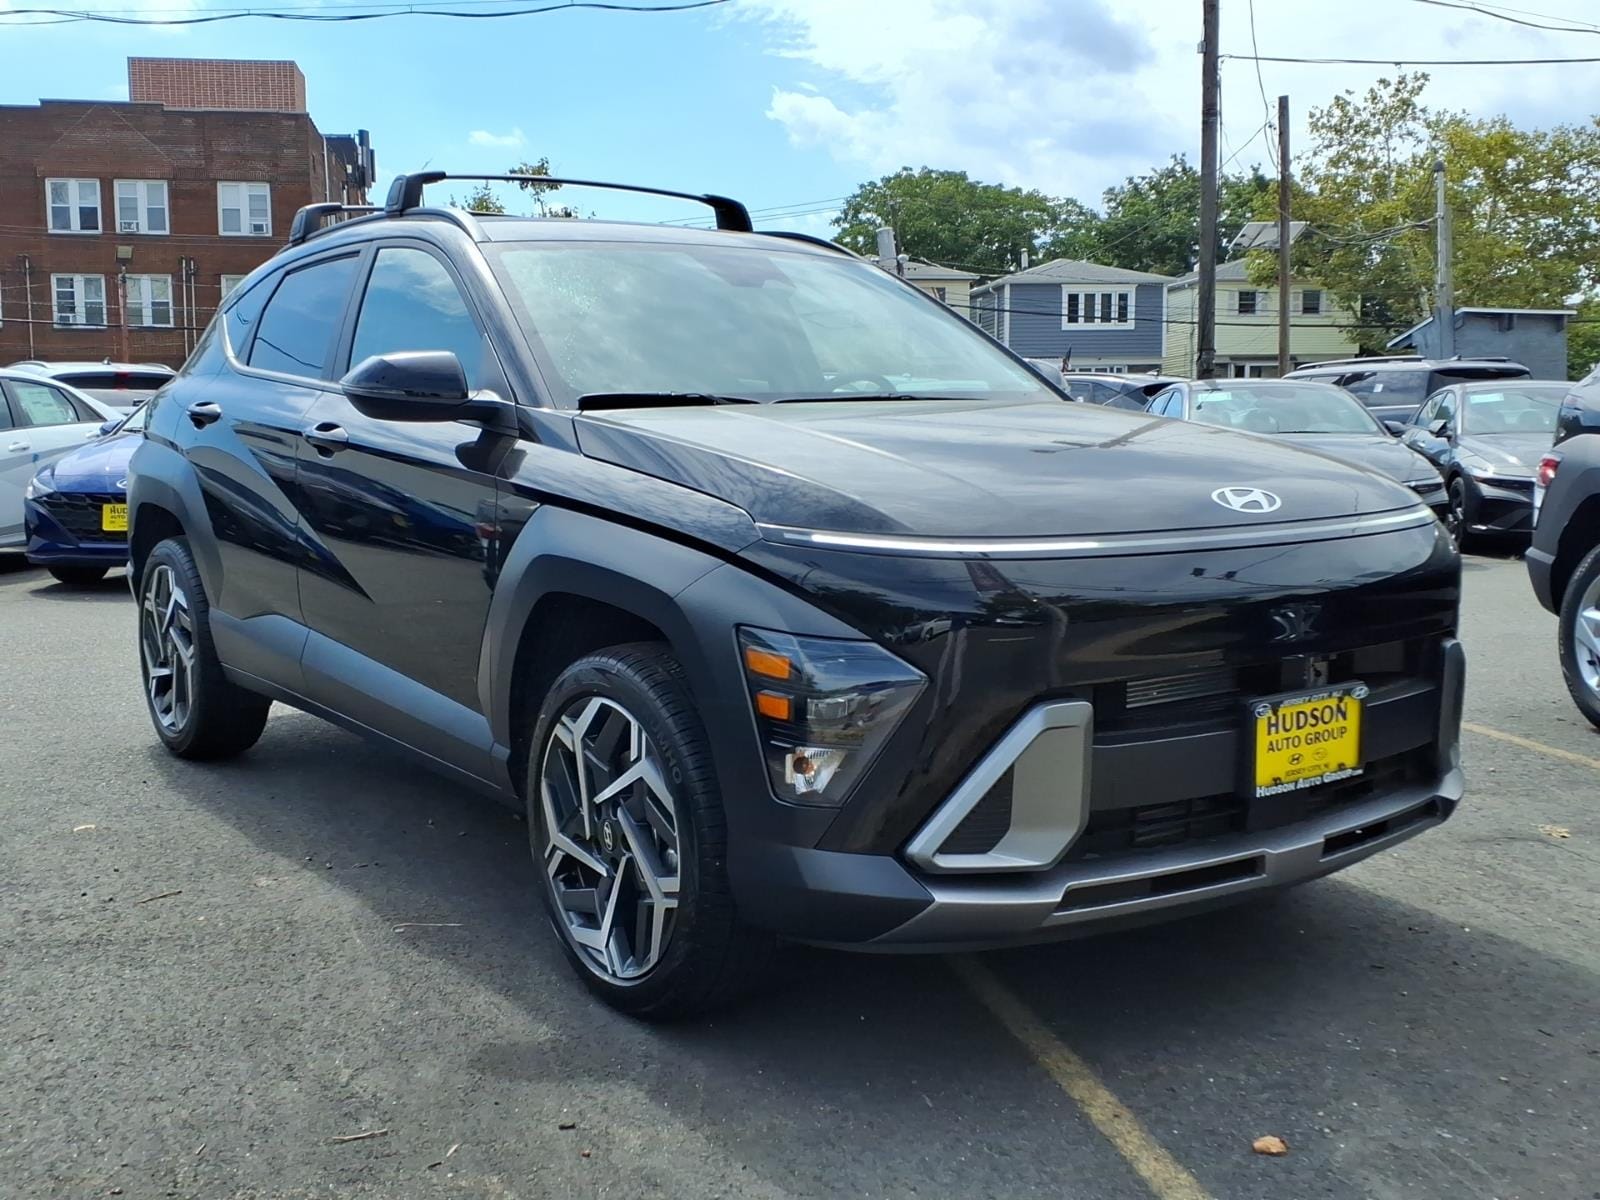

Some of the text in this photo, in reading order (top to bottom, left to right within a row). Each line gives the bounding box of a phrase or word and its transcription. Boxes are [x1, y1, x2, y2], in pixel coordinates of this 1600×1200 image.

[1267, 702, 1347, 736] HUDSON
[1267, 726, 1347, 753] AUTO GROUP
